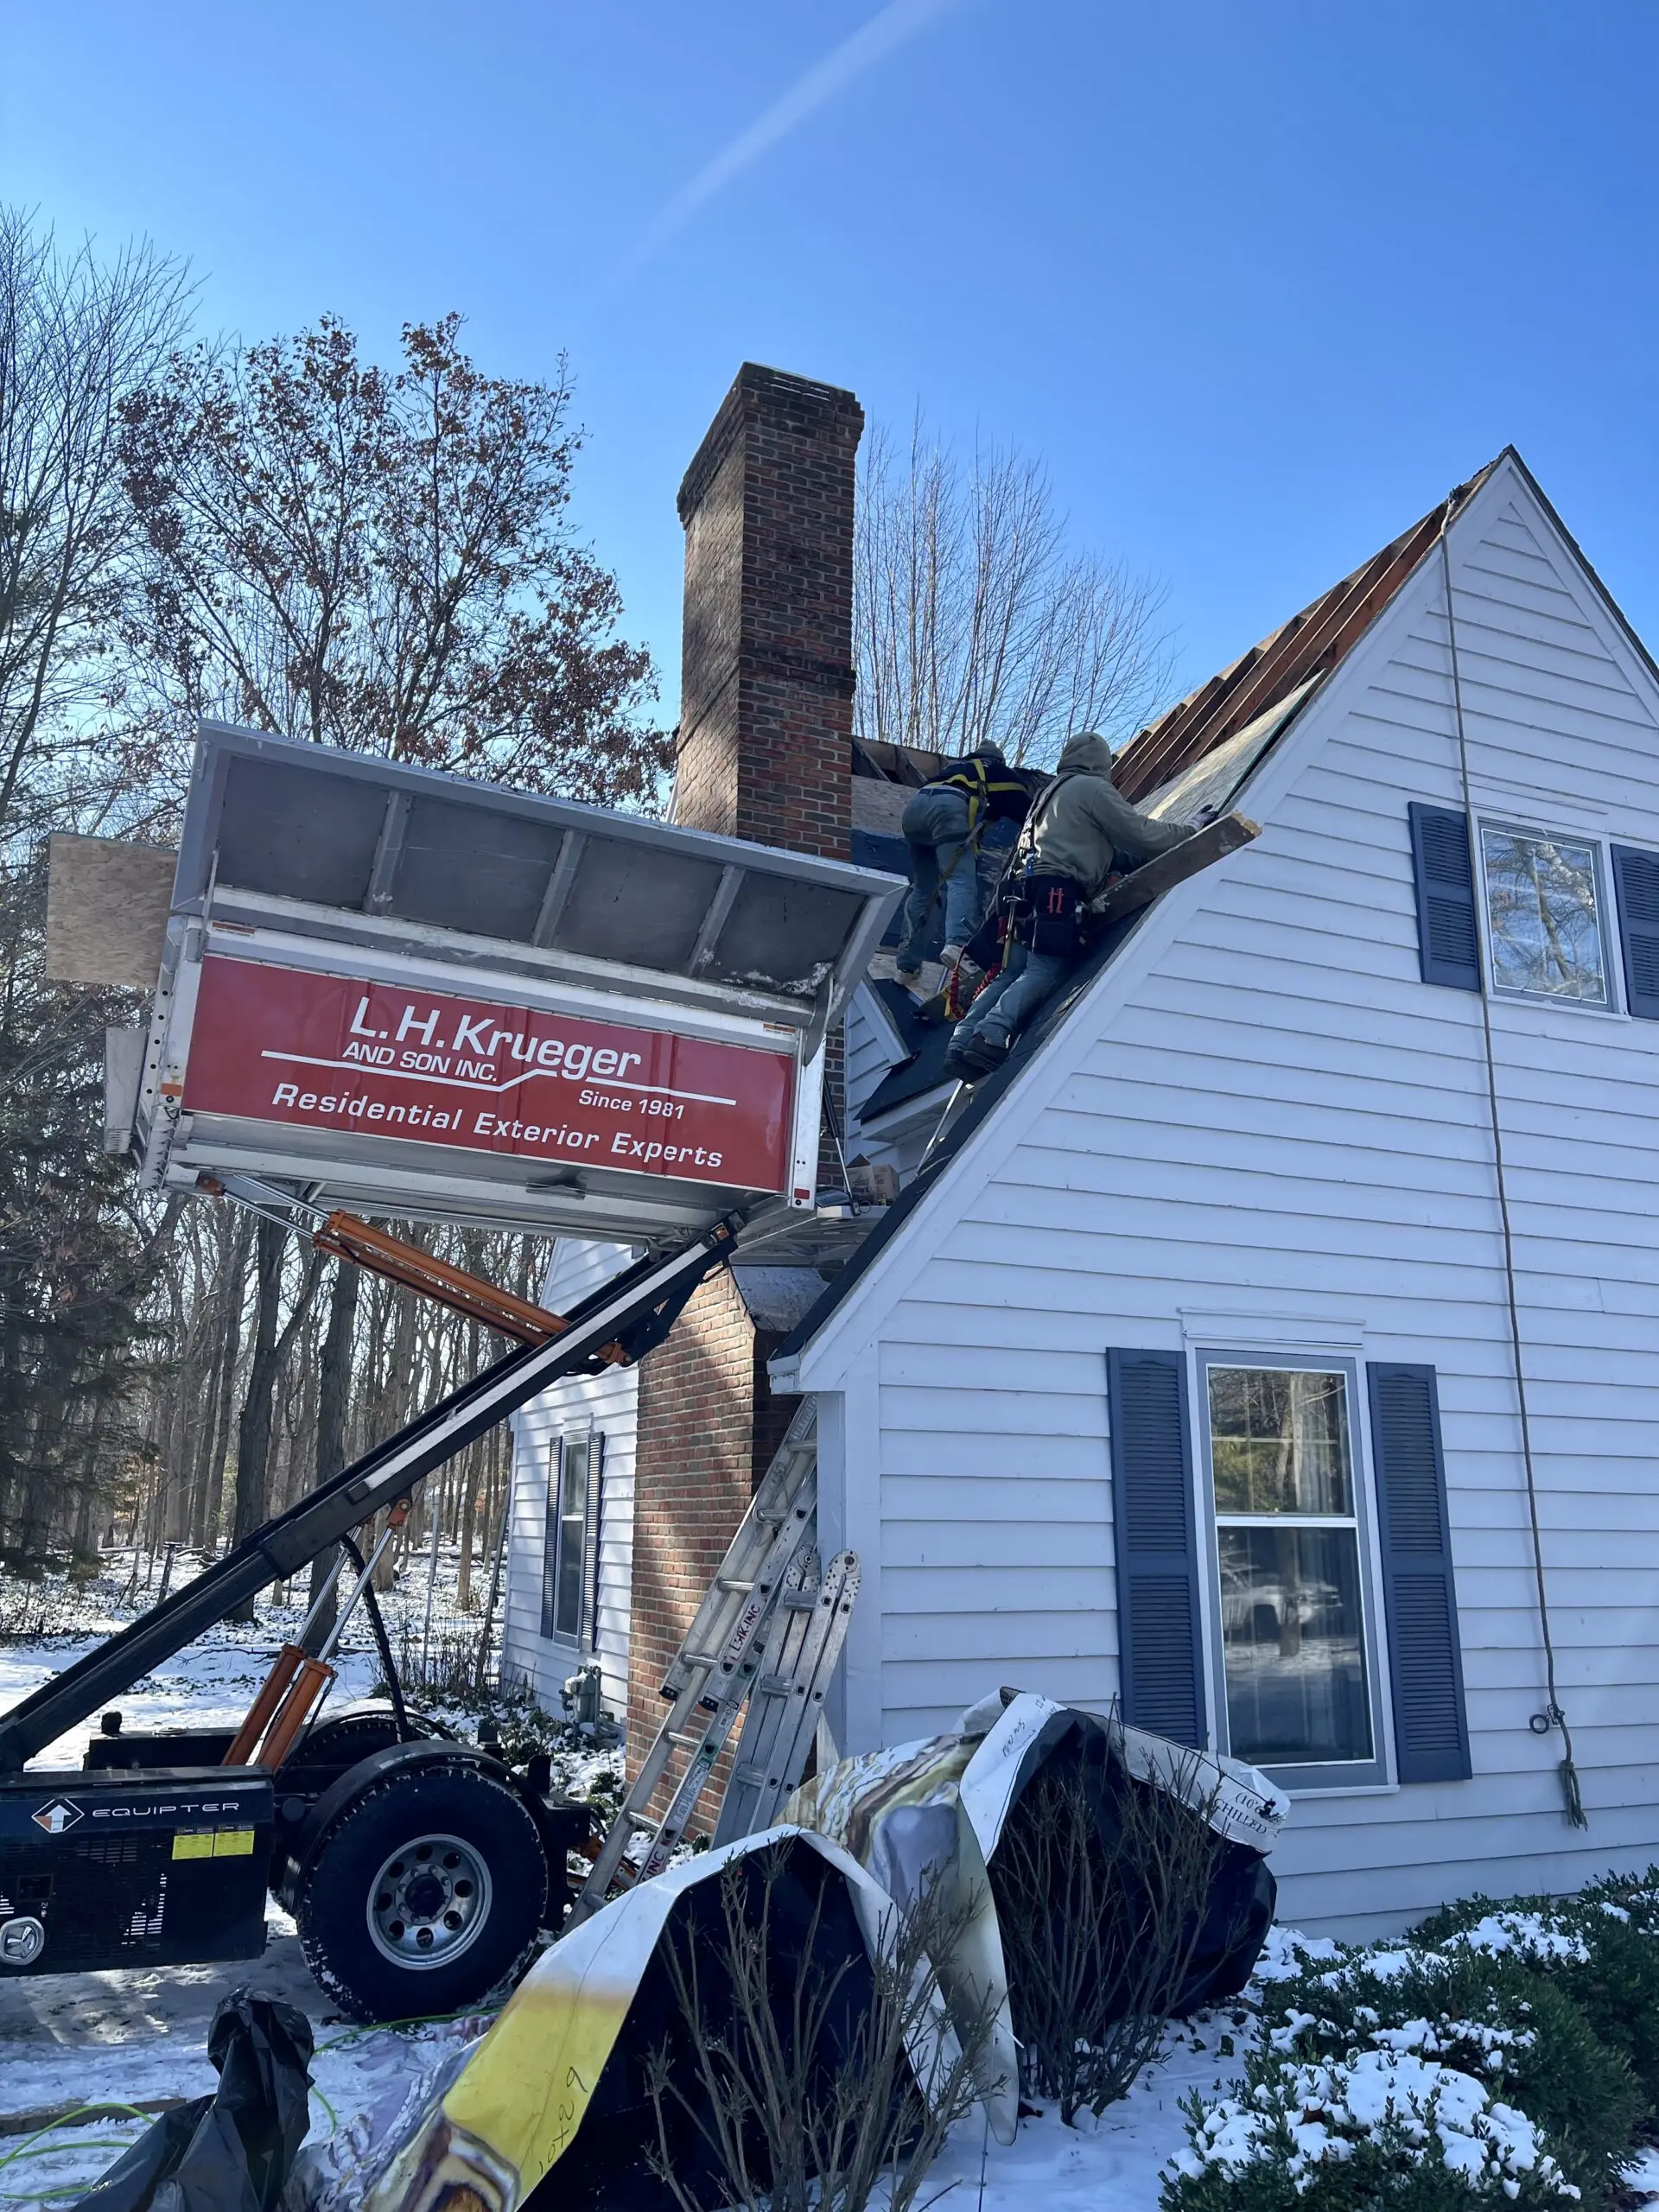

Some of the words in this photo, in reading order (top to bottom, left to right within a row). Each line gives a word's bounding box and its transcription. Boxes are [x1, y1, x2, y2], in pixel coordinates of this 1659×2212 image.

[342, 1041, 396, 1065] AND
[399, 1052, 452, 1074] SON
[454, 1058, 498, 1082] INC.
[578, 1089, 632, 1112] Since
[639, 1099, 684, 1120] 1981
[272, 1083, 463, 1130] Residential
[473, 1112, 600, 1150] Exterior
[610, 1132, 723, 1168] Experts
[92, 1802, 239, 1817] EQUIPTER
[1213, 1798, 1268, 1834] CHILLED
